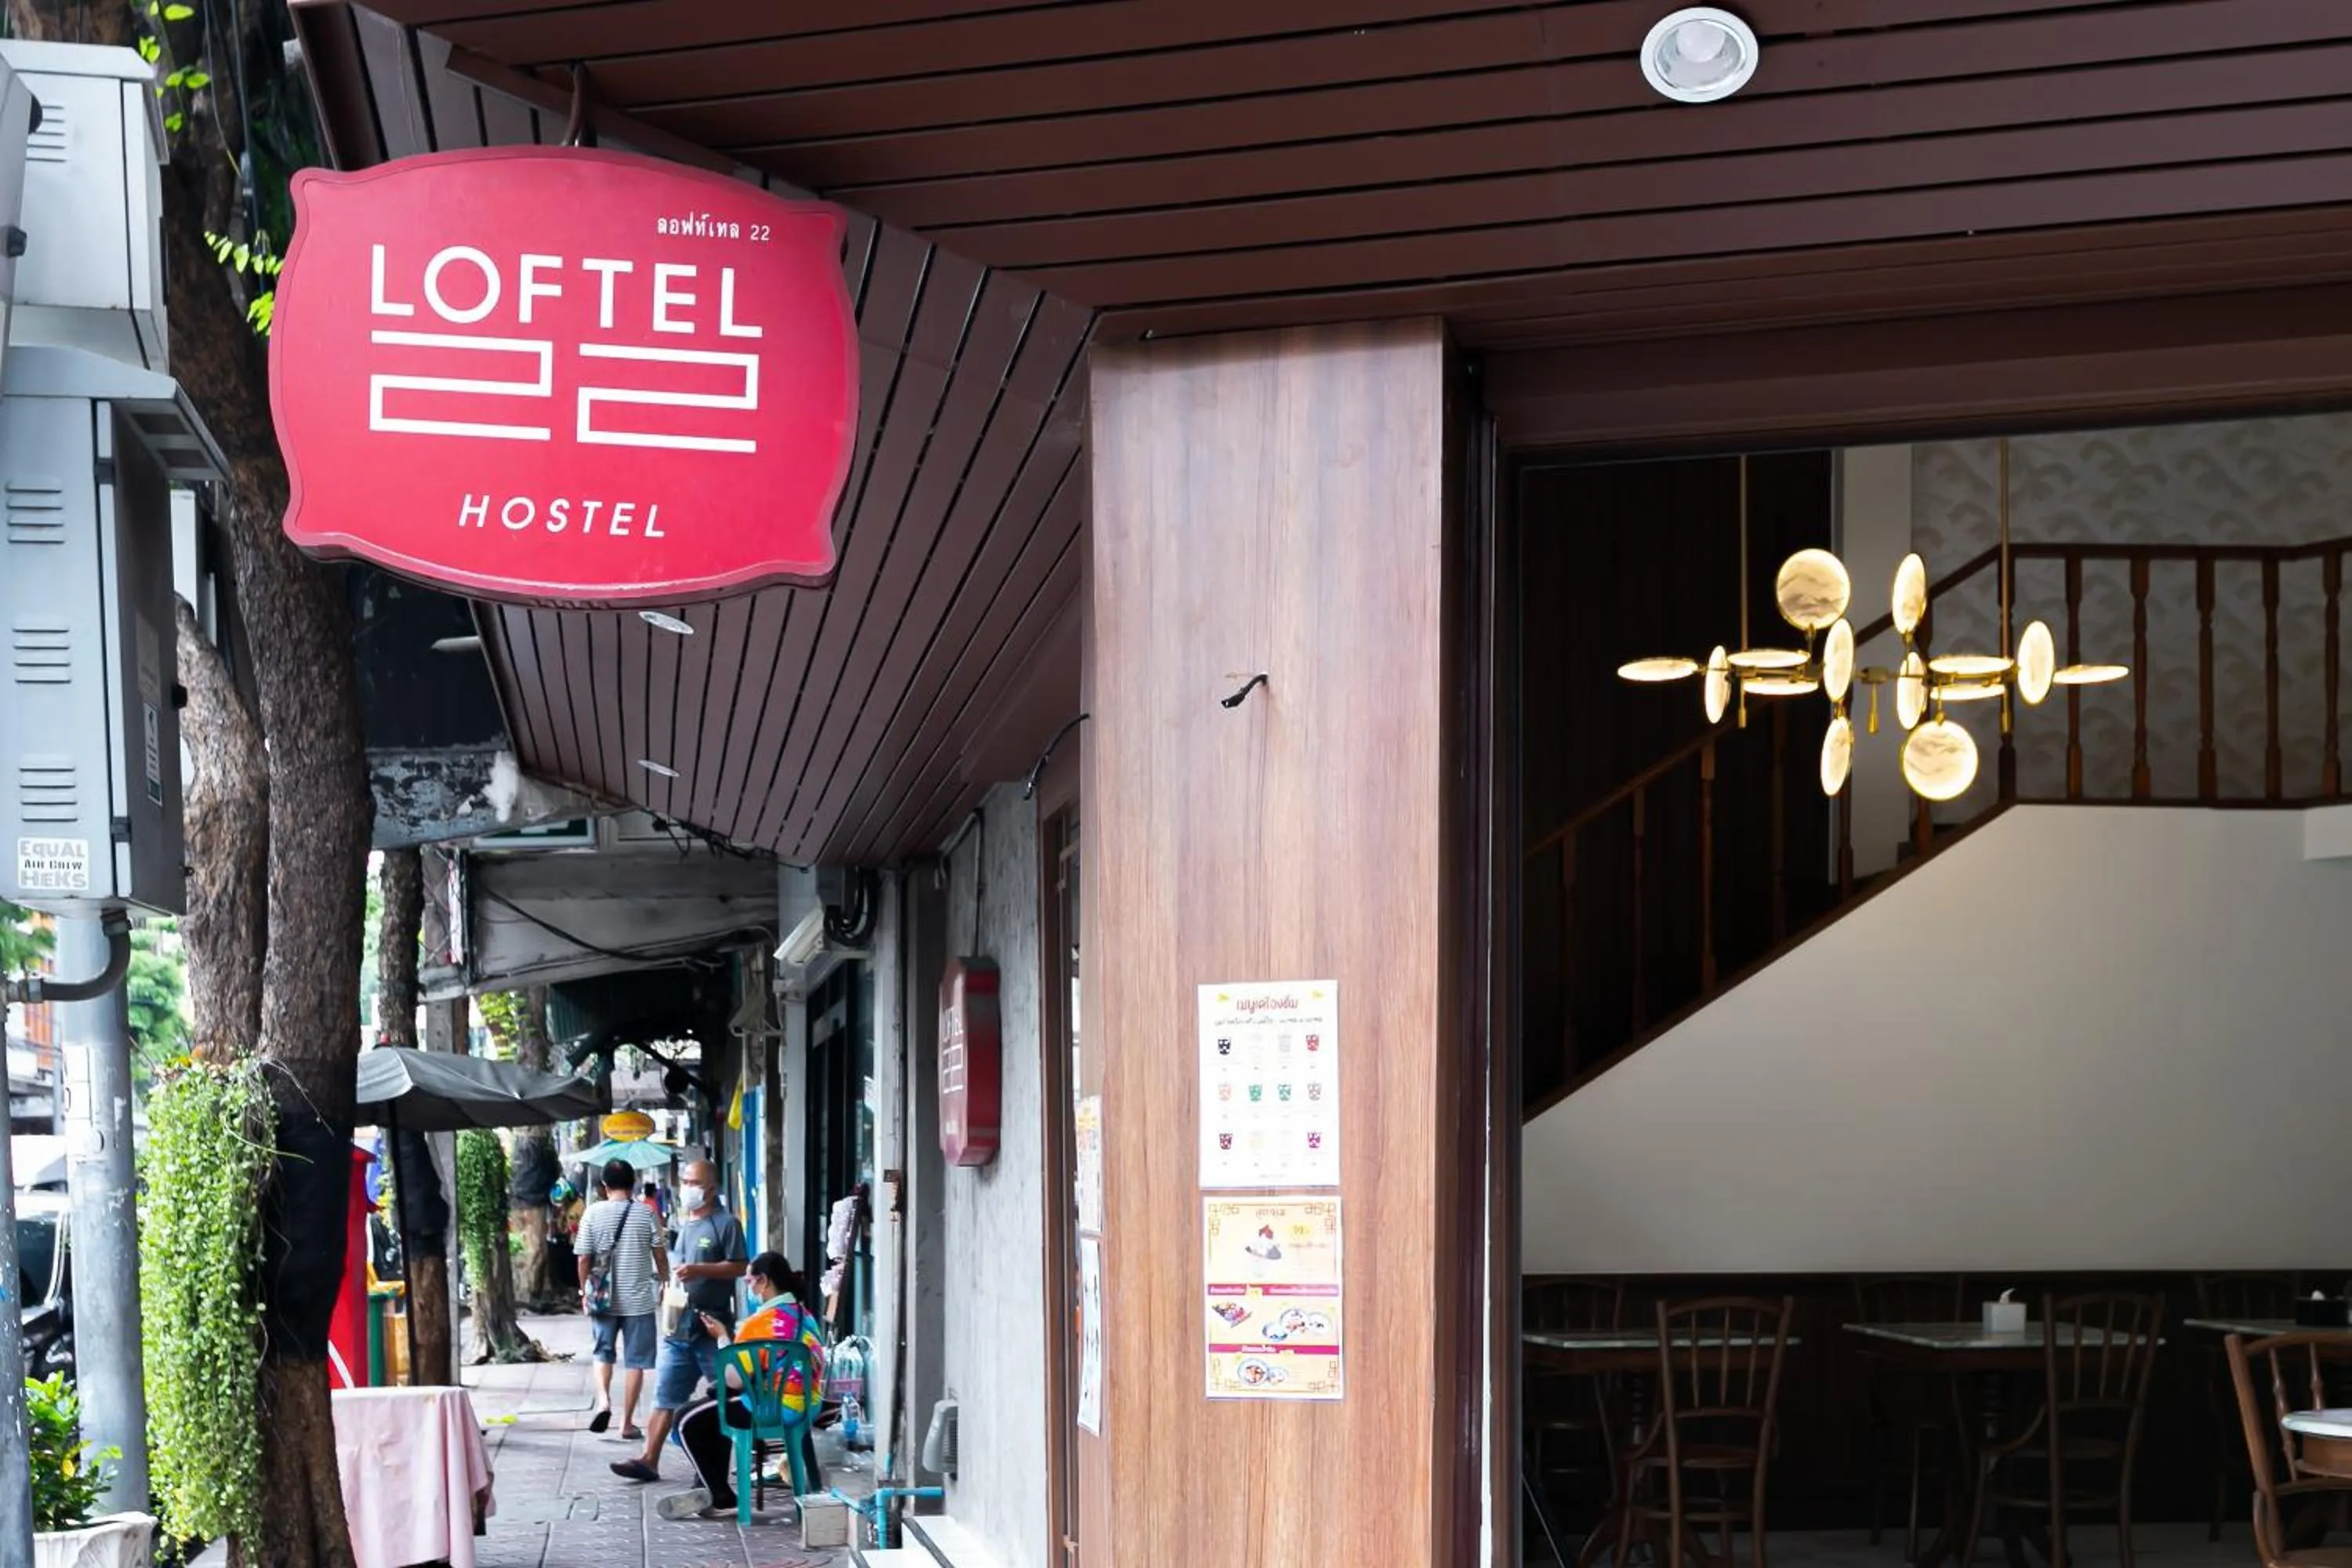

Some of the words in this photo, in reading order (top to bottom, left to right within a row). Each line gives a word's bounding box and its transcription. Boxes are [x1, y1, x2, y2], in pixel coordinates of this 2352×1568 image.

[750, 223, 771, 241] 22
[371, 244, 763, 338] LOFTEL
[369, 329, 759, 453] 22
[458, 494, 666, 538] HOSTEL
[20, 840, 85, 858] EQUAL
[20, 870, 86, 887] HEKS
